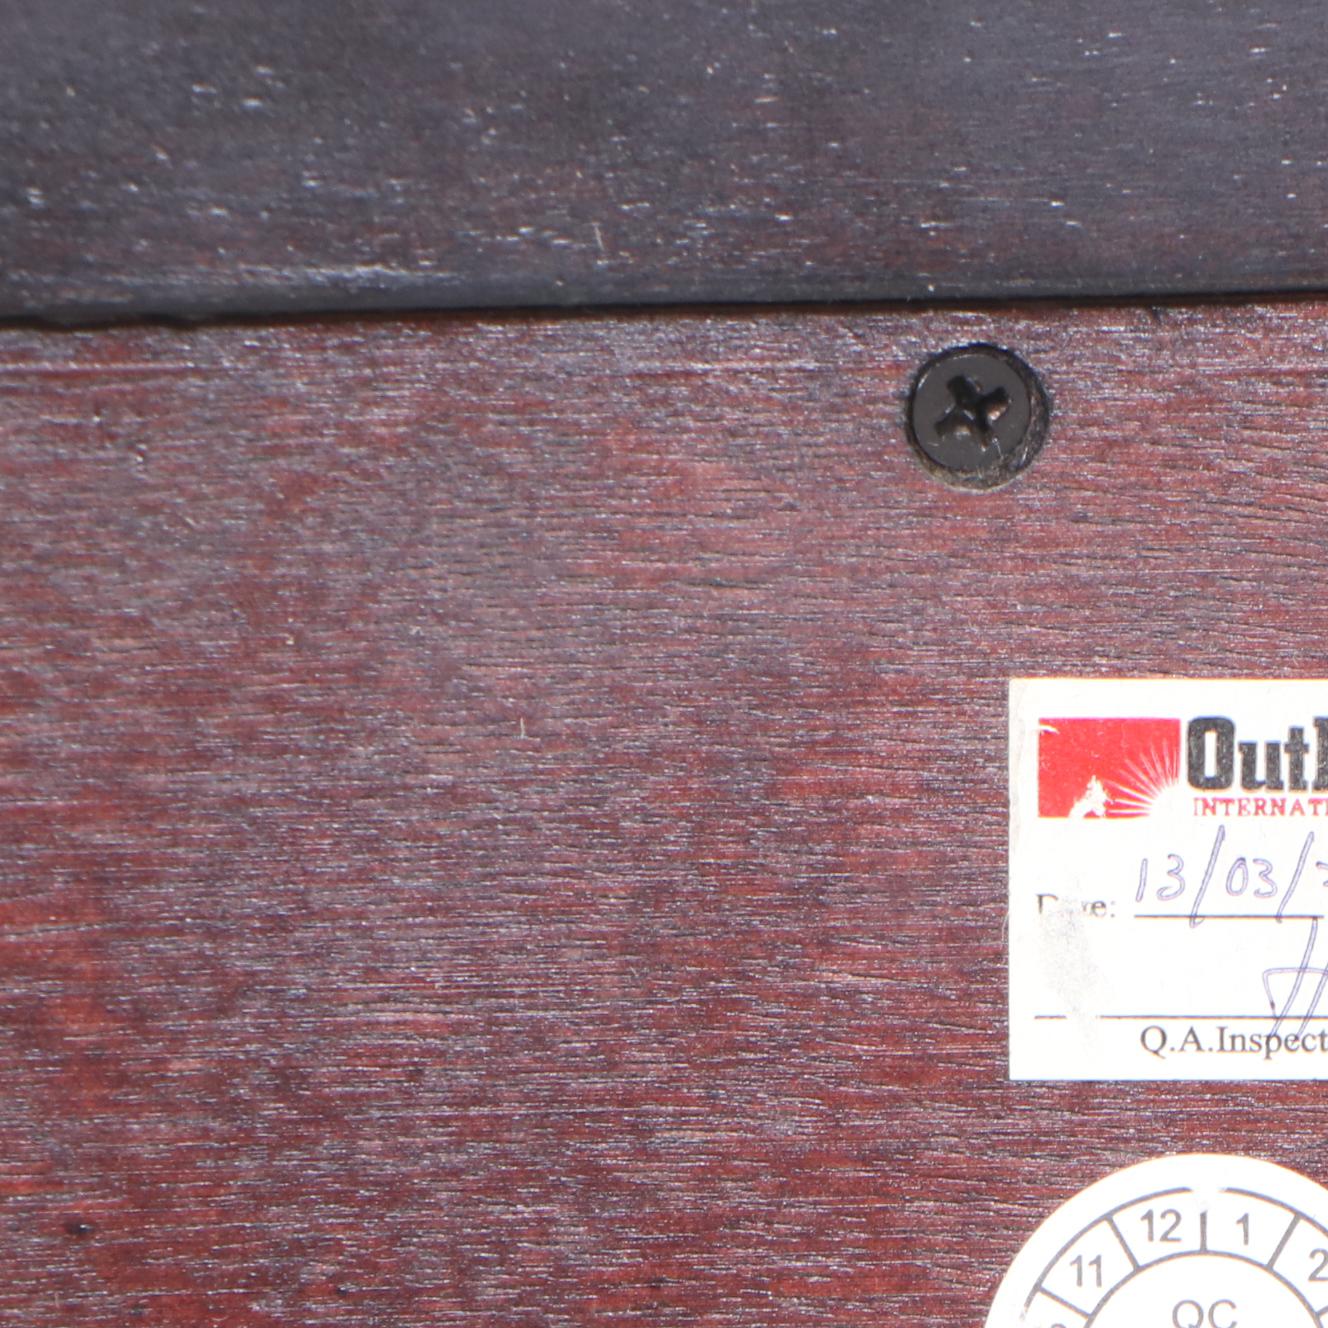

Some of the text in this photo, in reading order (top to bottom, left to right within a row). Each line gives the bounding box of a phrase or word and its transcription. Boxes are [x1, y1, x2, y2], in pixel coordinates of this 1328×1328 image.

[1140, 1209, 1183, 1242] 12
[1235, 1213, 1250, 1245] 1
[1069, 1254, 1103, 1288] 11
